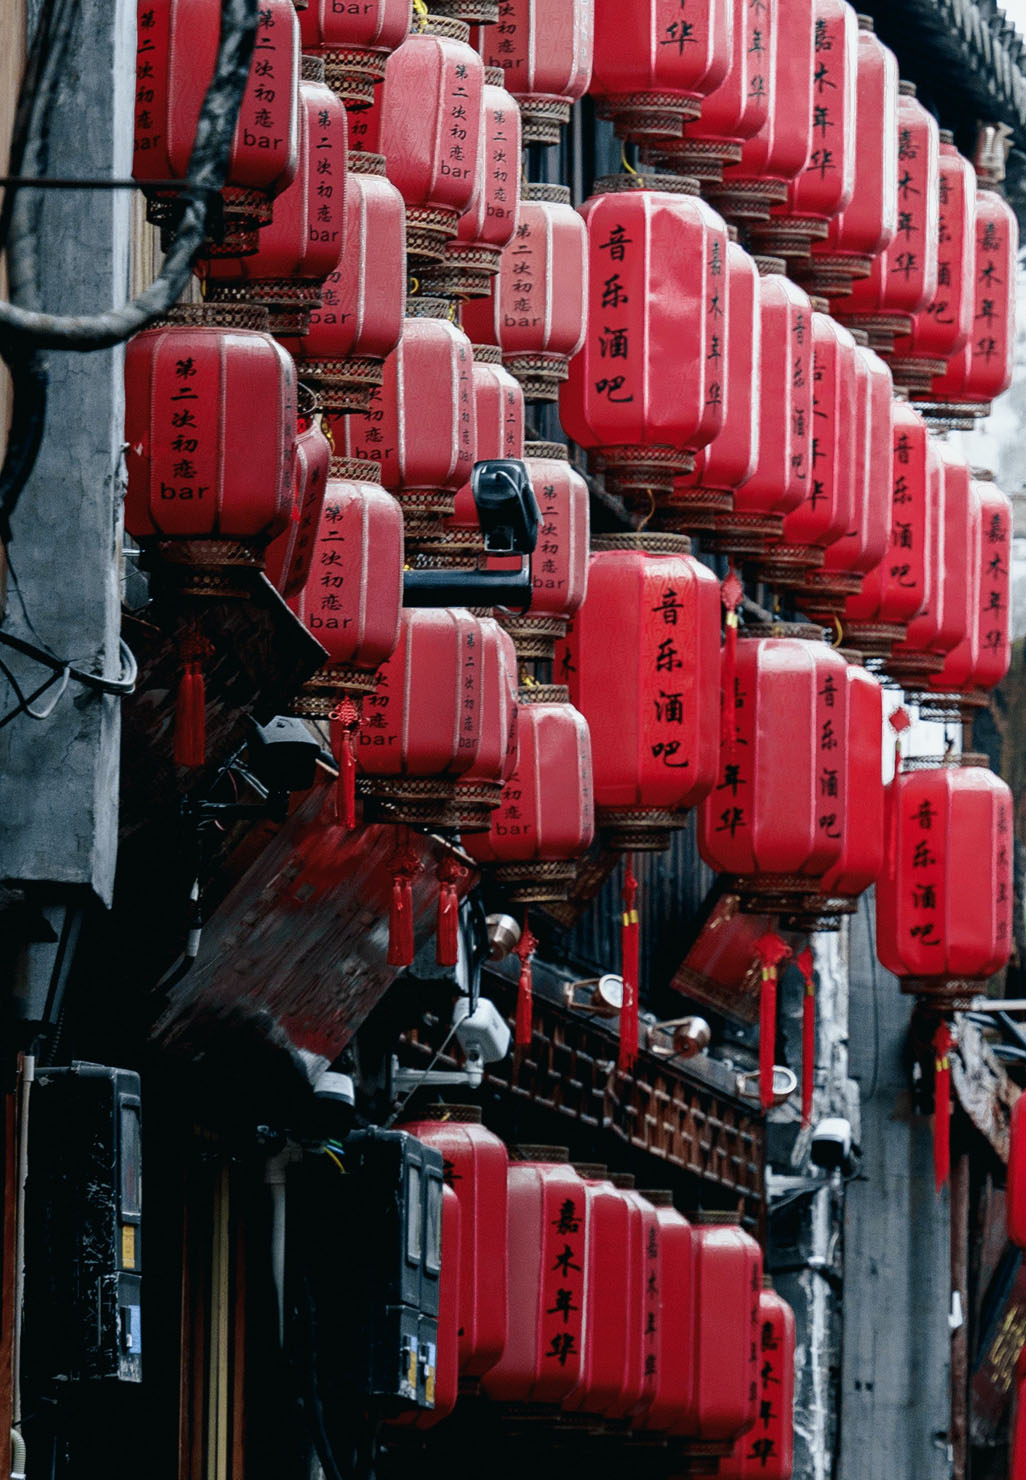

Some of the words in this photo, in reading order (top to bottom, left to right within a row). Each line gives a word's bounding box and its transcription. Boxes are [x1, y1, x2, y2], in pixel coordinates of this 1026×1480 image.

[136, 9, 156, 129] 第二次初恋
[254, 9, 276, 128] 第二次初恋
[488, 56, 524, 68] bar
[807, 19, 837, 179] 嘉木年华
[243, 129, 284, 150] bar
[449, 64, 469, 161] 第二次初恋
[492, 111, 508, 202] 第二次初恋
[316, 110, 333, 222] 第二次初恋
[440, 160, 471, 179] bar
[486, 202, 513, 218] bar
[895, 129, 920, 281] 嘉木年华
[309, 225, 339, 242] bar
[512, 223, 533, 312] 第二次初恋
[504, 314, 541, 327] bar
[595, 225, 634, 404] 音乐酒吧
[706, 241, 723, 417] 嘉木年华
[974, 222, 1002, 364] 嘉木年华
[170, 357, 199, 479] 第二次初恋
[355, 446, 394, 461] bar
[364, 386, 384, 443] 次初恋
[160, 482, 210, 501] bar
[541, 486, 559, 573] 第二次初恋
[890, 433, 917, 588] 音乐酒吧
[320, 506, 345, 610] 第二次初恋
[533, 576, 565, 589] bar
[983, 513, 1007, 654] 嘉木年华
[310, 613, 353, 629] bar
[368, 660, 389, 729] 次初恋
[464, 633, 475, 731] 第二次初恋
[651, 588, 688, 768] 音乐酒吧
[359, 731, 398, 746] bar
[459, 736, 478, 748] bar
[819, 675, 841, 838] 音乐酒吧
[495, 822, 531, 836] bar
[910, 800, 941, 946] 音乐酒吧
[546, 1198, 582, 1366] 嘉木年华
[747, 1320, 782, 1467] 嘉木年华
